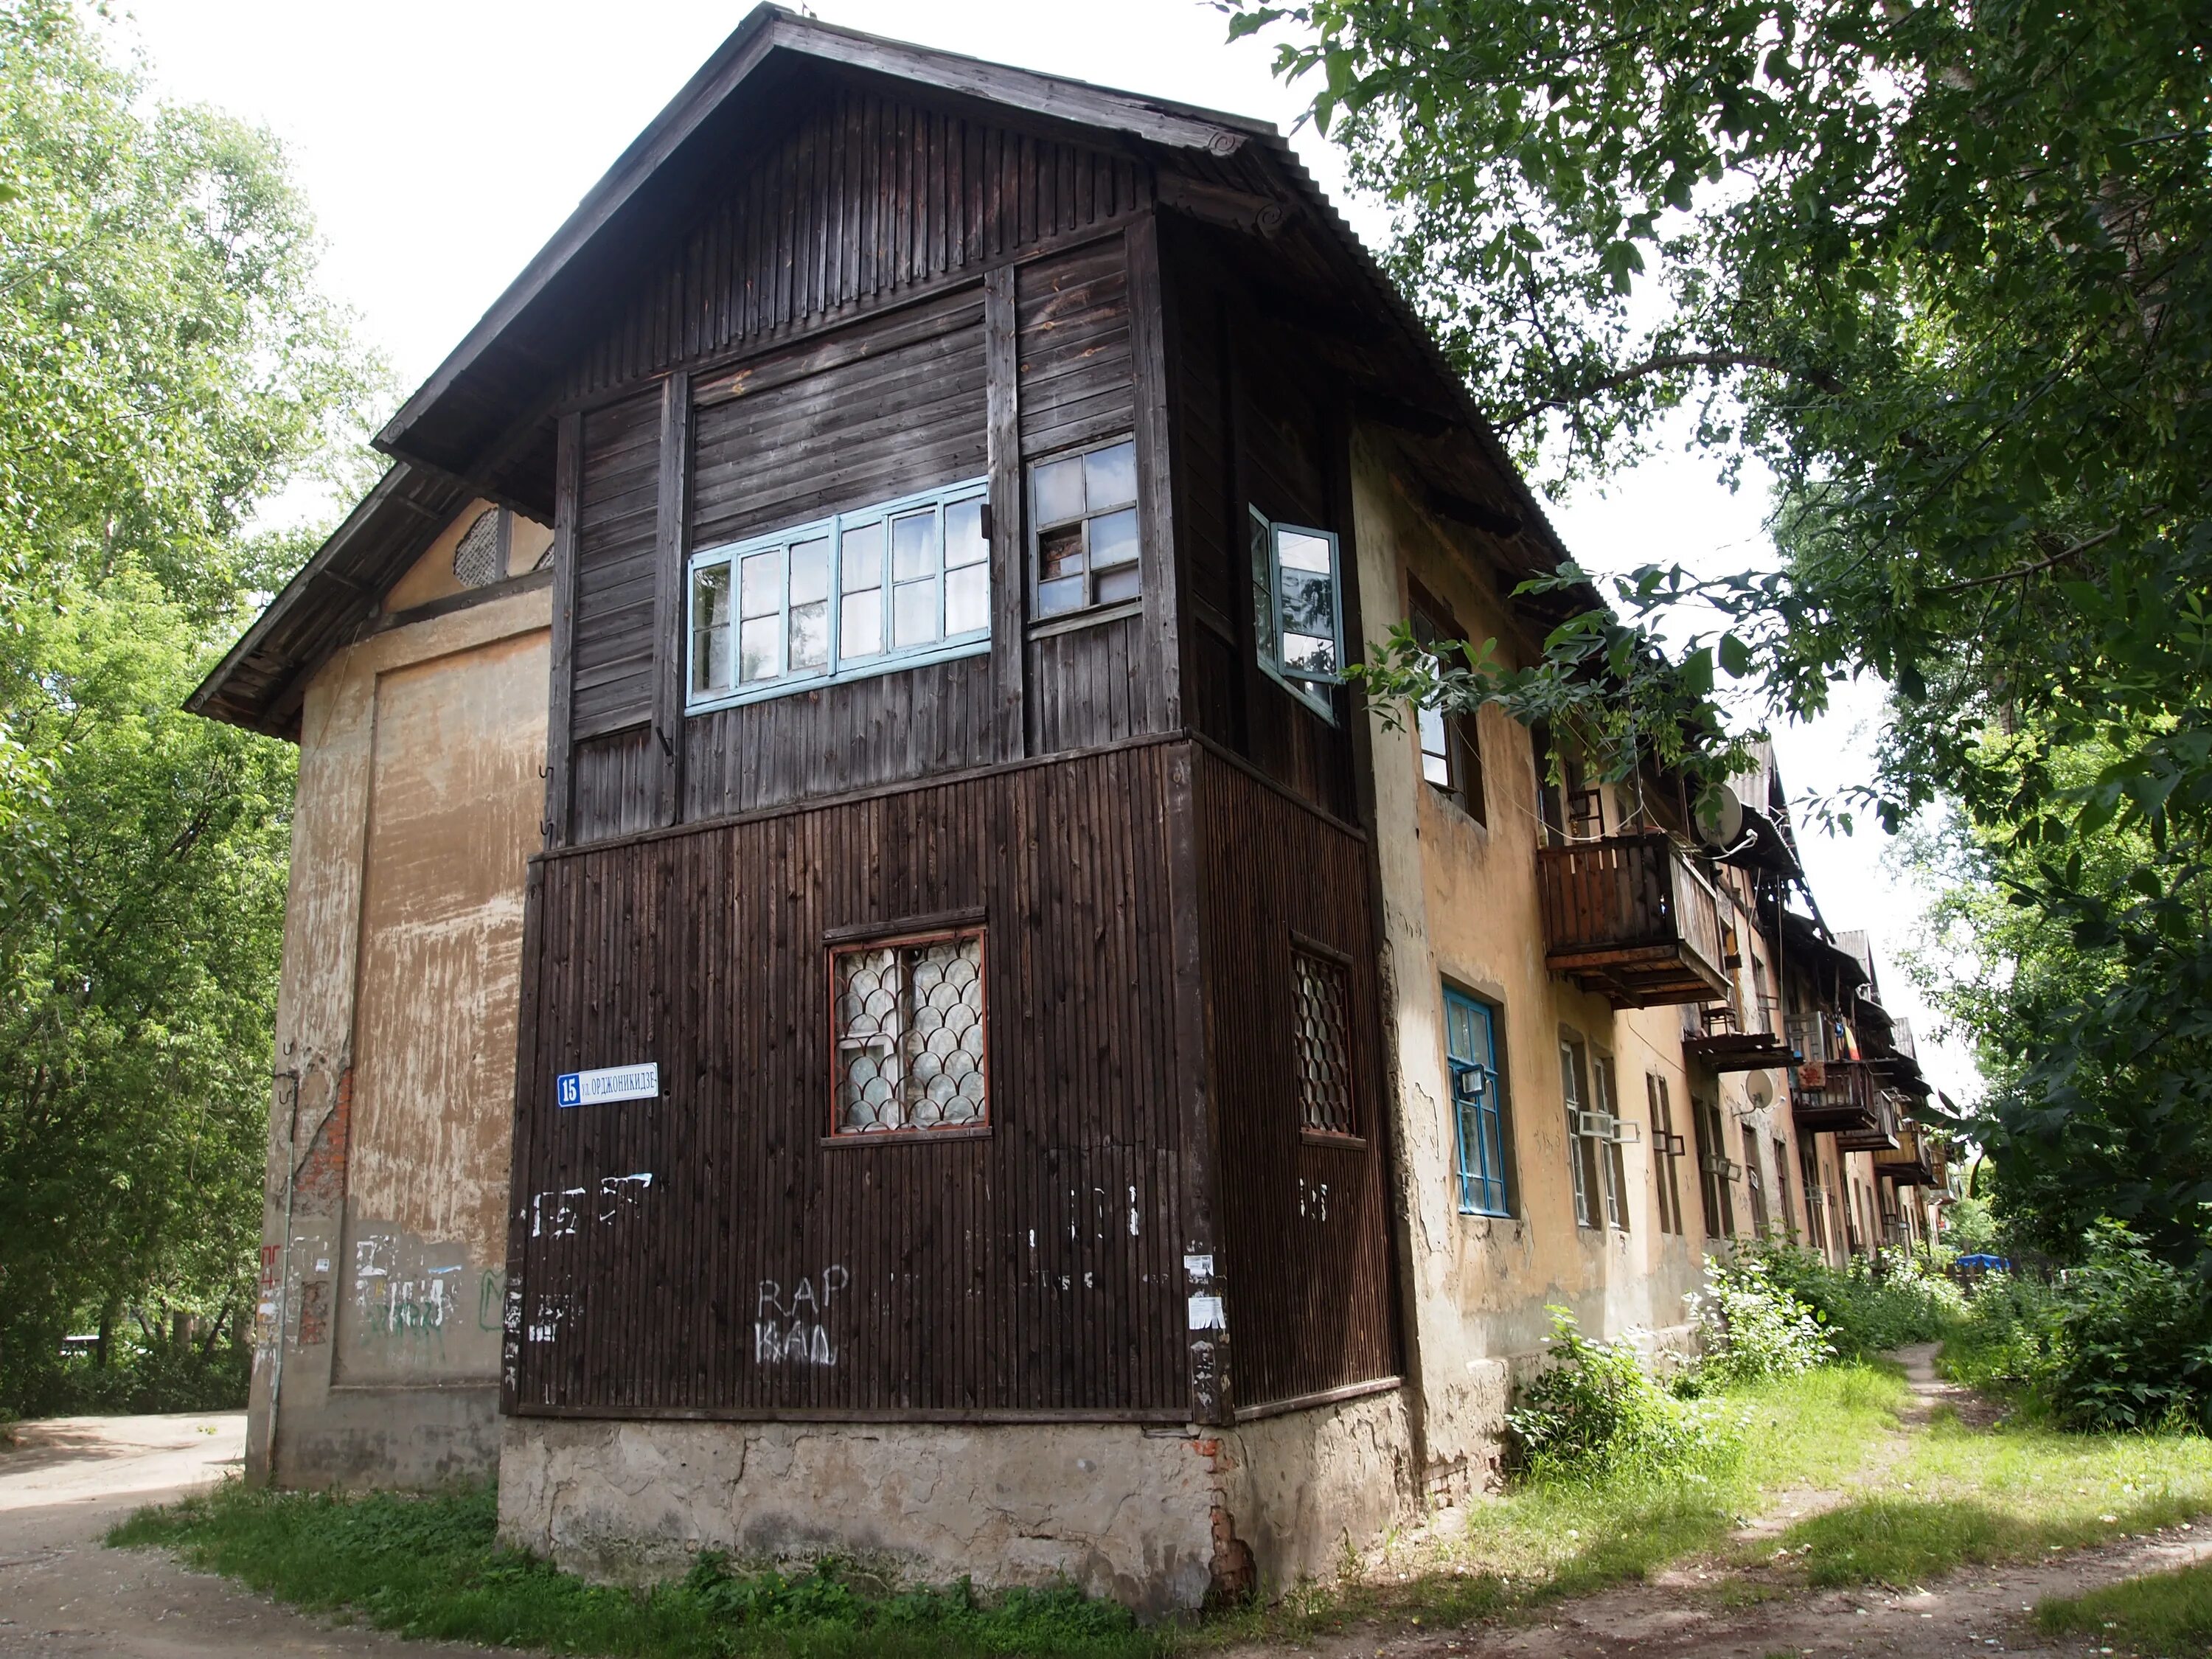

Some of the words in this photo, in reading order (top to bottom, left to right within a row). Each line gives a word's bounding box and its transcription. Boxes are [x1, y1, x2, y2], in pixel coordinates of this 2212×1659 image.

[563, 1079, 577, 1102] 15
[591, 1072, 655, 1095] ОРДЖОНИКИДЗЕ
[759, 1265, 849, 1318] RAP
